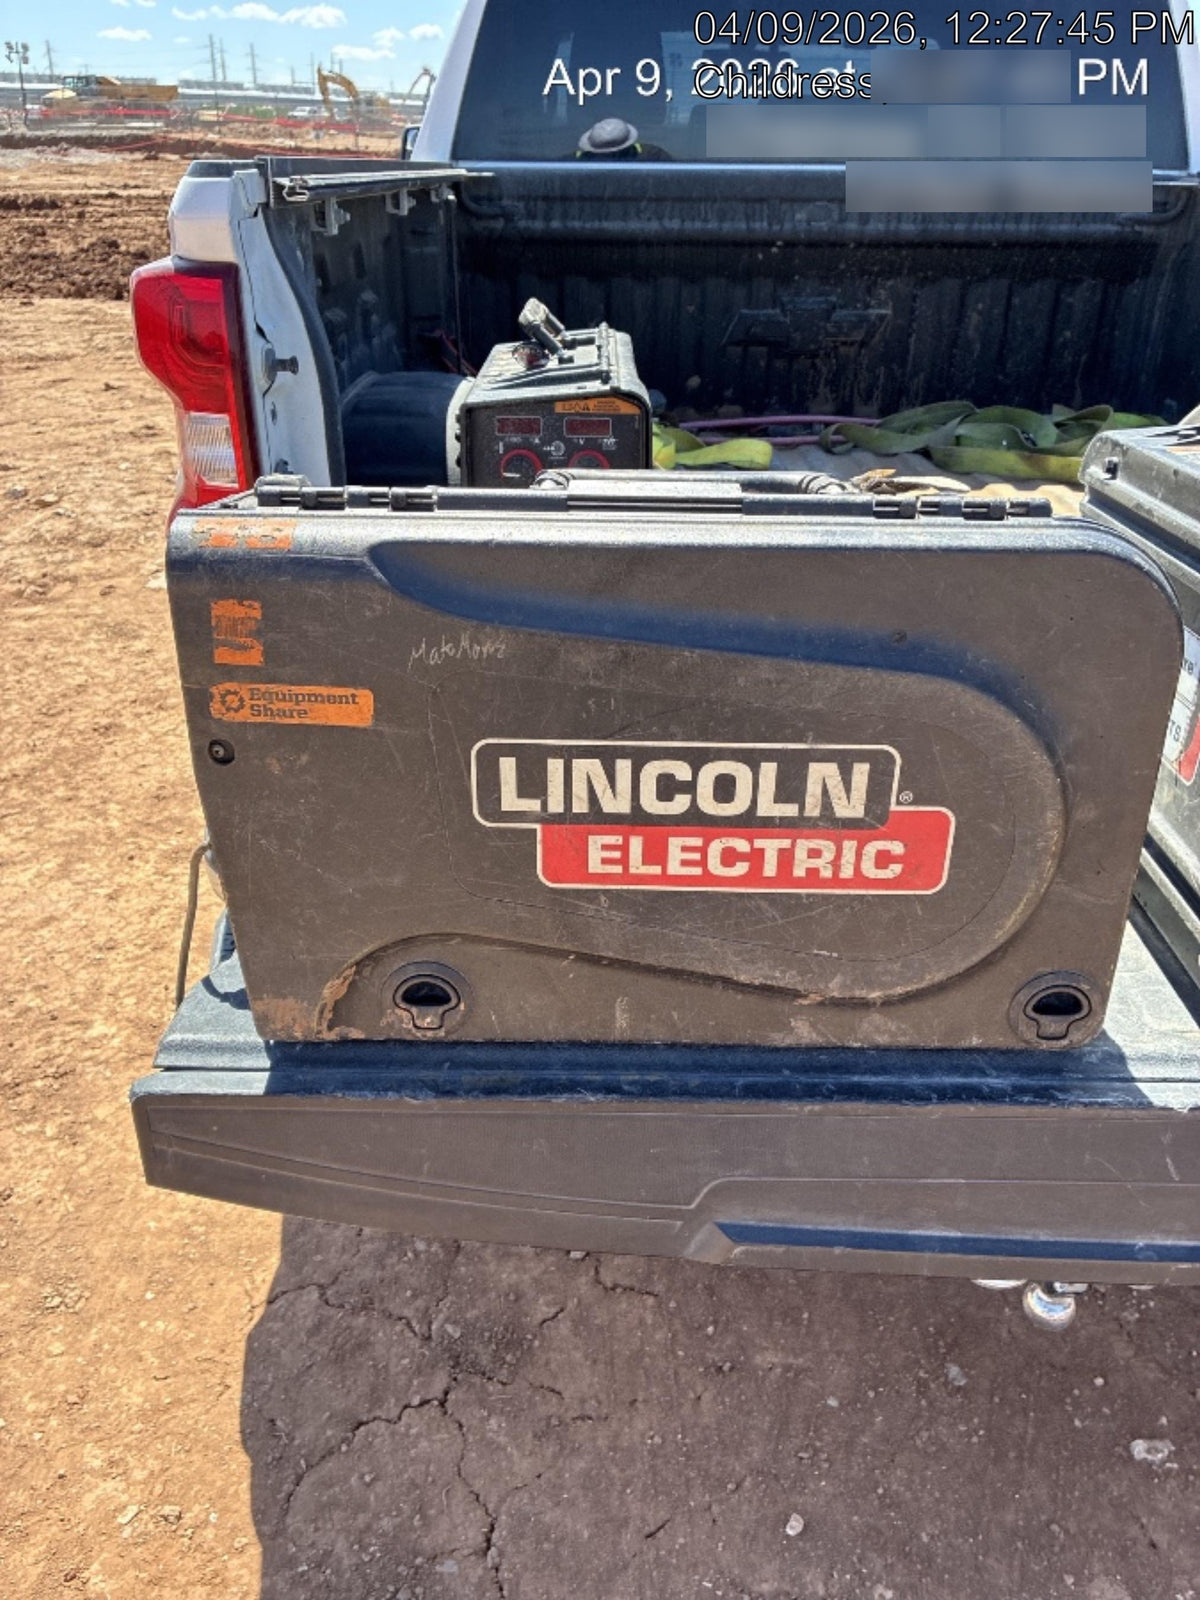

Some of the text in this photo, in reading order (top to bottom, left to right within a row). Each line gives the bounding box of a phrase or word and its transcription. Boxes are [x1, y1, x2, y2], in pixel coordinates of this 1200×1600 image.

[248, 687, 360, 706] Equipment
[250, 704, 309, 720] Share
[499, 756, 870, 819] LINCOLN
[586, 834, 906, 880] ELECTRIC
